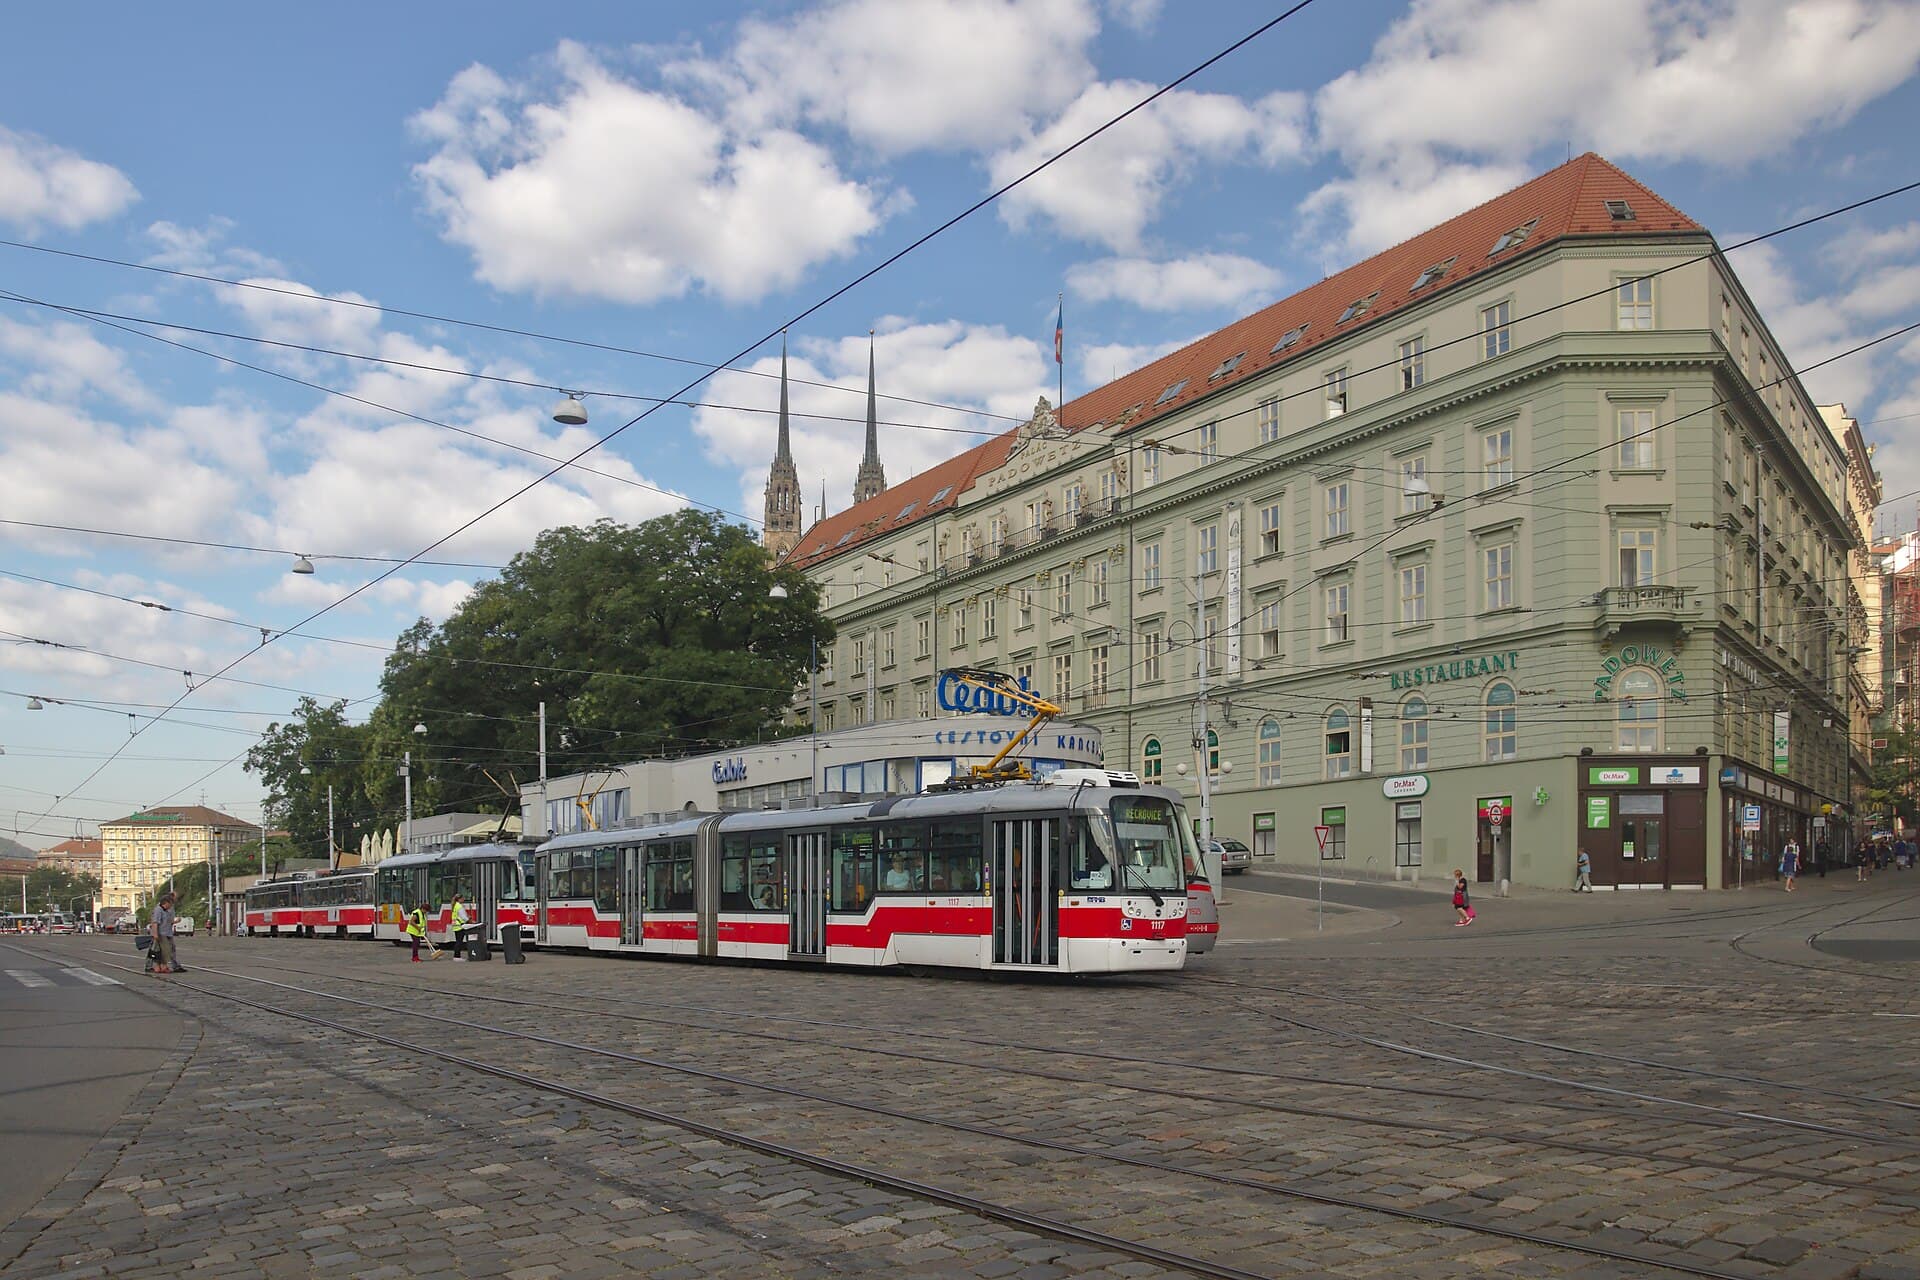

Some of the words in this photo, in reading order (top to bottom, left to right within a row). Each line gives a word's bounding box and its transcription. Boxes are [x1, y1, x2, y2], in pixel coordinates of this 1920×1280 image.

[988, 439, 1081, 487] PADOWETZ
[1391, 651, 1519, 690] RESTAURANT
[1594, 642, 1688, 704] PADOWETZ
[1151, 920, 1165, 930] 1117
